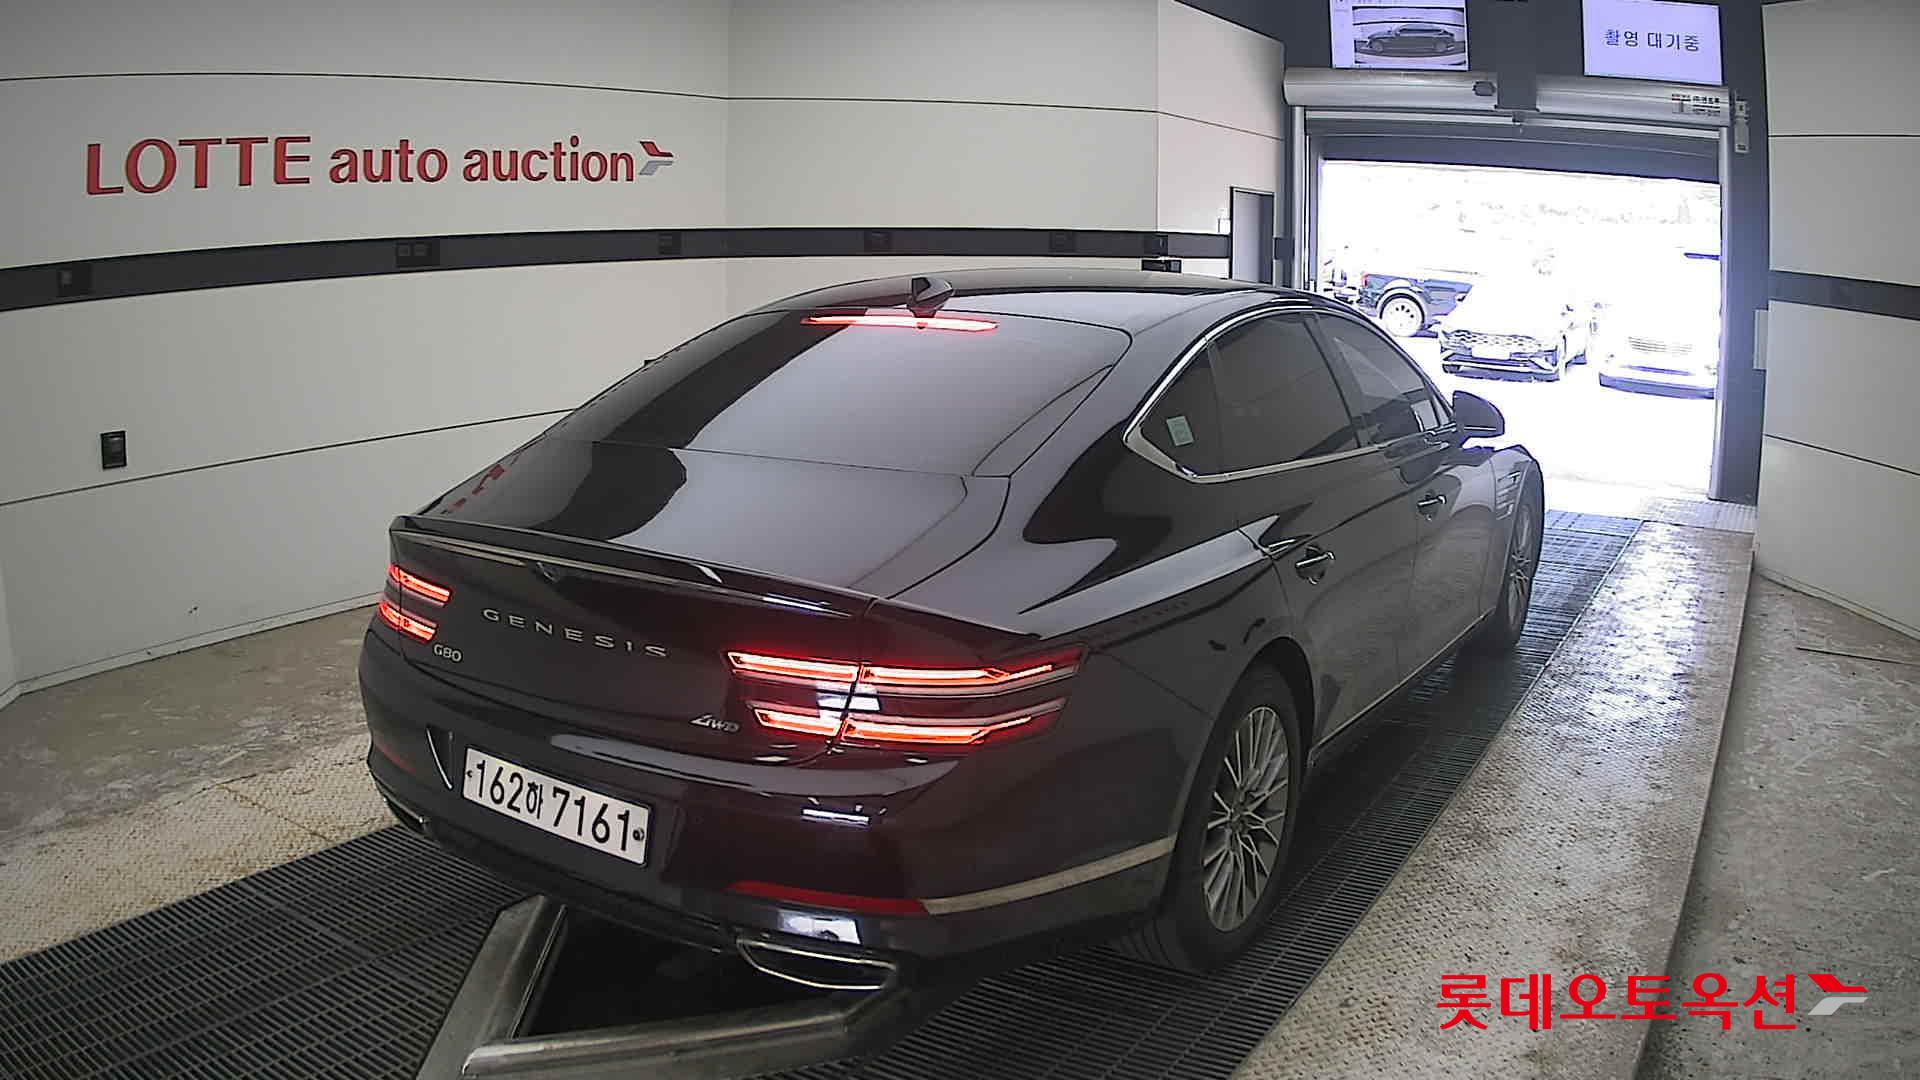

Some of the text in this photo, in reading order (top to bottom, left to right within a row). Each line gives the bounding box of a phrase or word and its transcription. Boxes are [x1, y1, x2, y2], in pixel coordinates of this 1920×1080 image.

[1647, 32, 1699, 52] 대기중
[87, 135, 634, 195] LOTTE auto auction
[483, 608, 667, 657] GENESIS
[433, 643, 462, 662] G80
